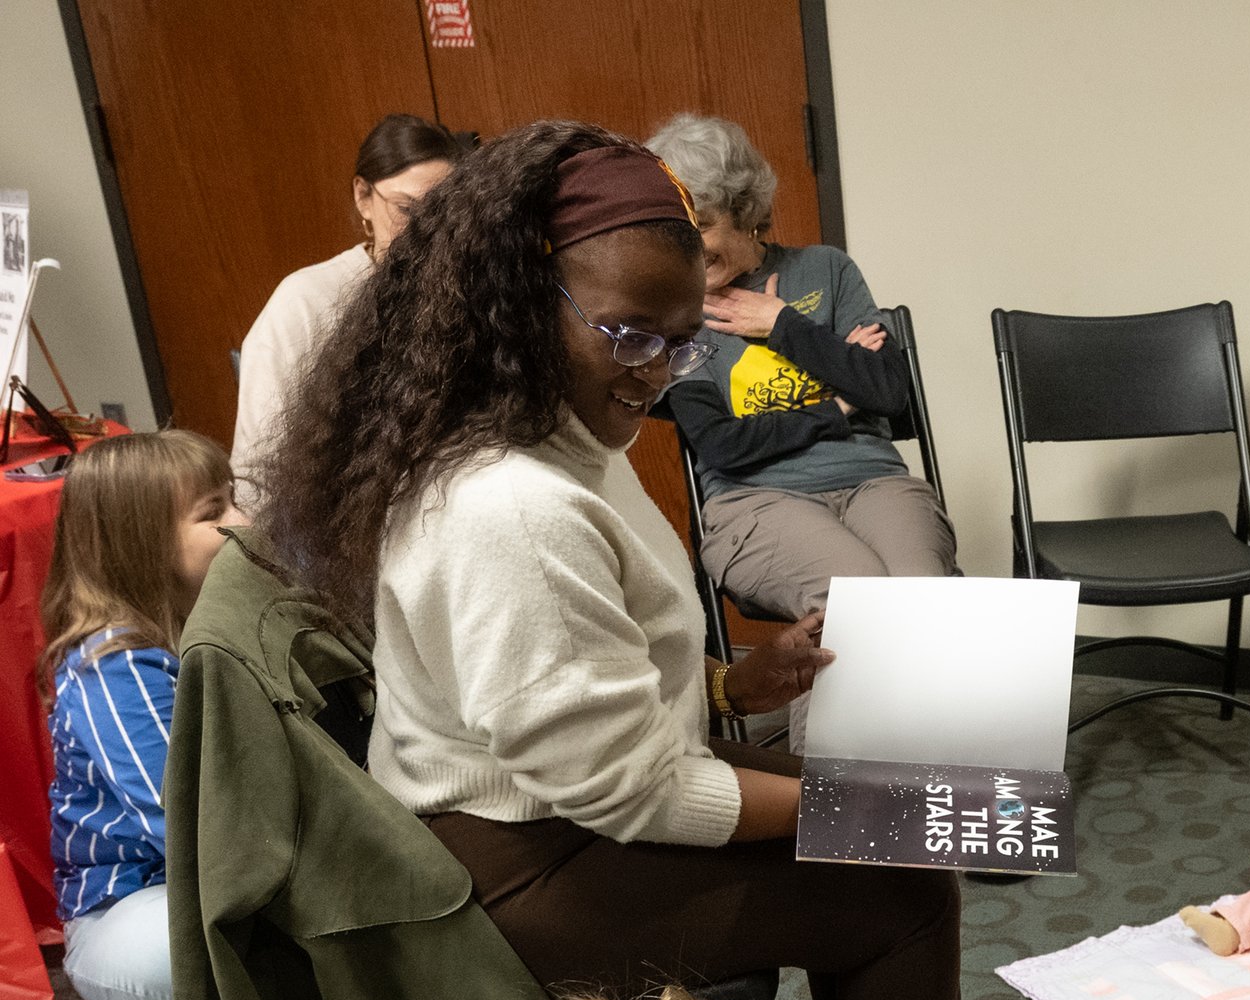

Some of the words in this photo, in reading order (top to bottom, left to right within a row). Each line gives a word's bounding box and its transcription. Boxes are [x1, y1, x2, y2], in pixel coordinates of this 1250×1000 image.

[924, 783, 954, 853] STARS
[961, 807, 989, 855] THE
[993, 776, 1026, 856] AMONG
[1030, 806, 1060, 859] MAE
